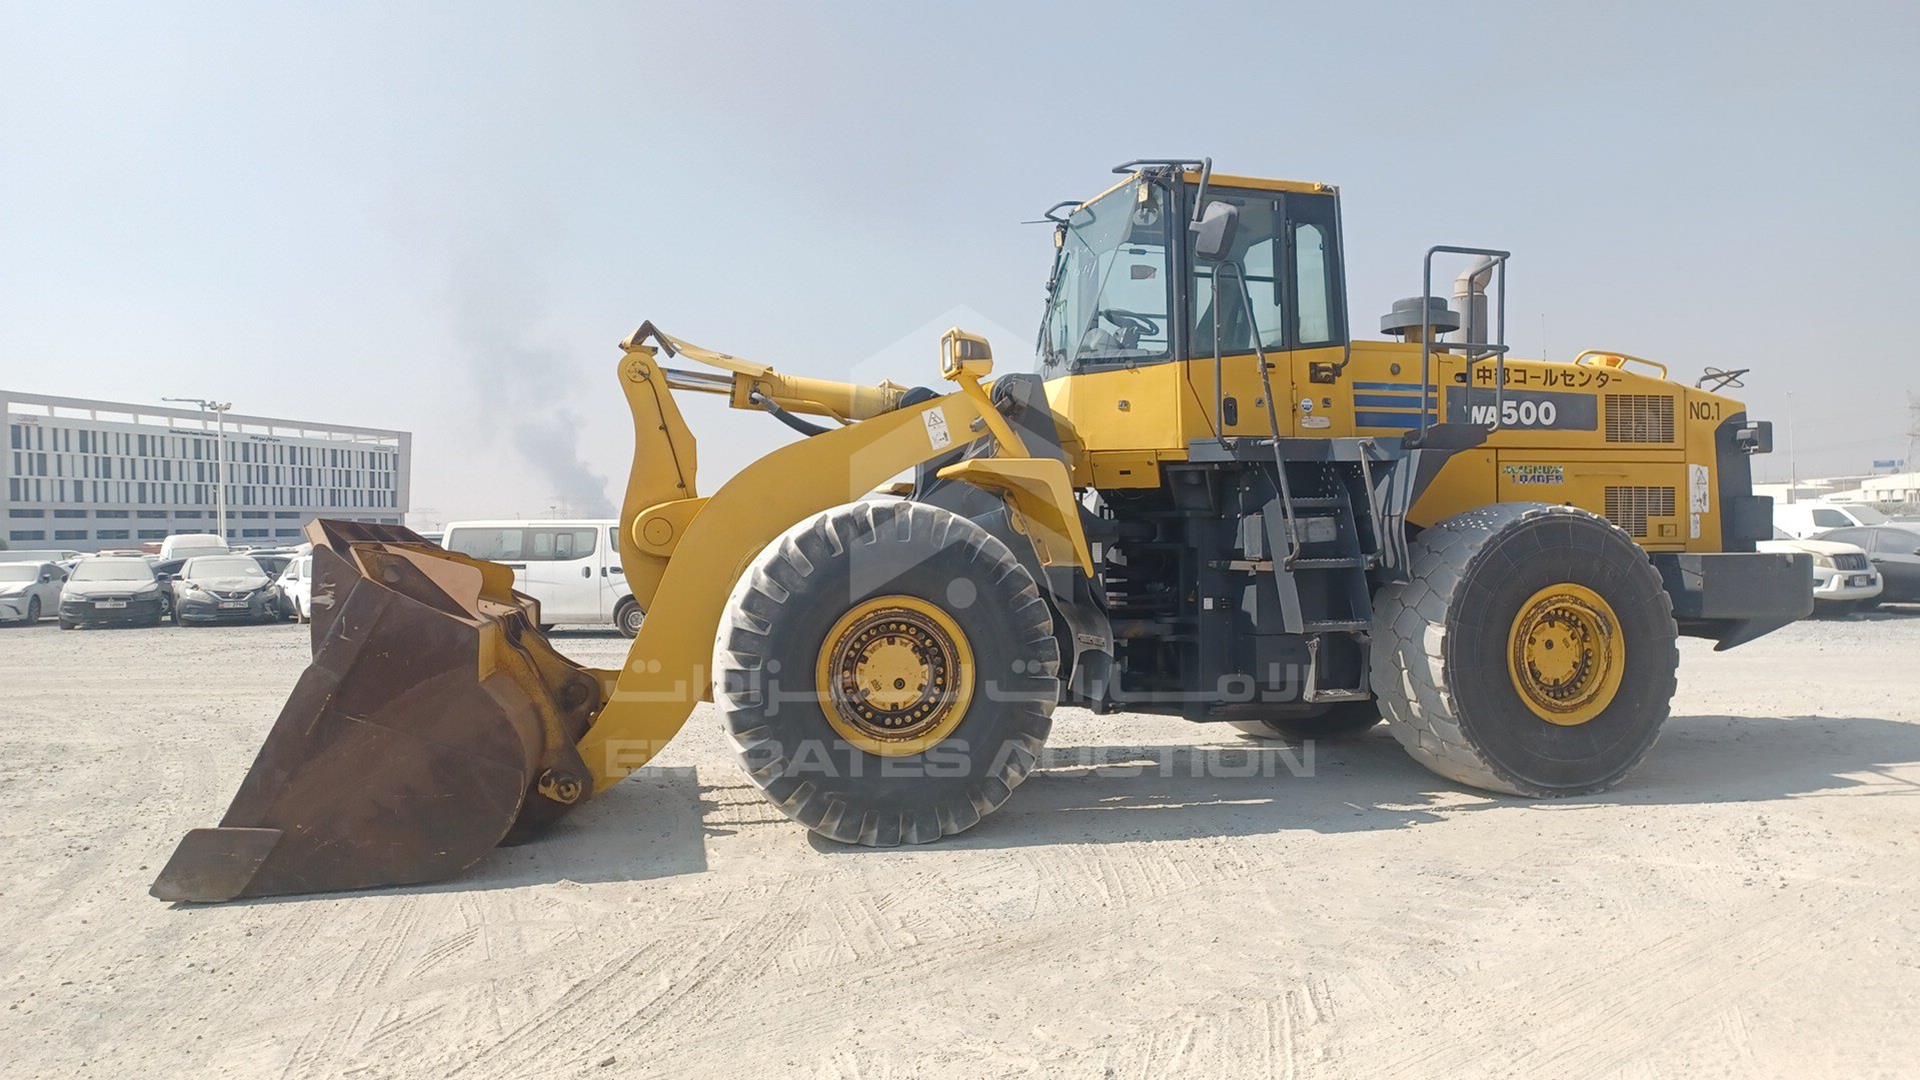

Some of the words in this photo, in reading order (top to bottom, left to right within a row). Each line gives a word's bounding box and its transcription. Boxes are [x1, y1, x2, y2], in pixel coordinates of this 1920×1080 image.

[1476, 365, 1623, 389] 中部コールセンター
[1464, 400, 1557, 426] WA500
[1689, 400, 1720, 421] NO.1
